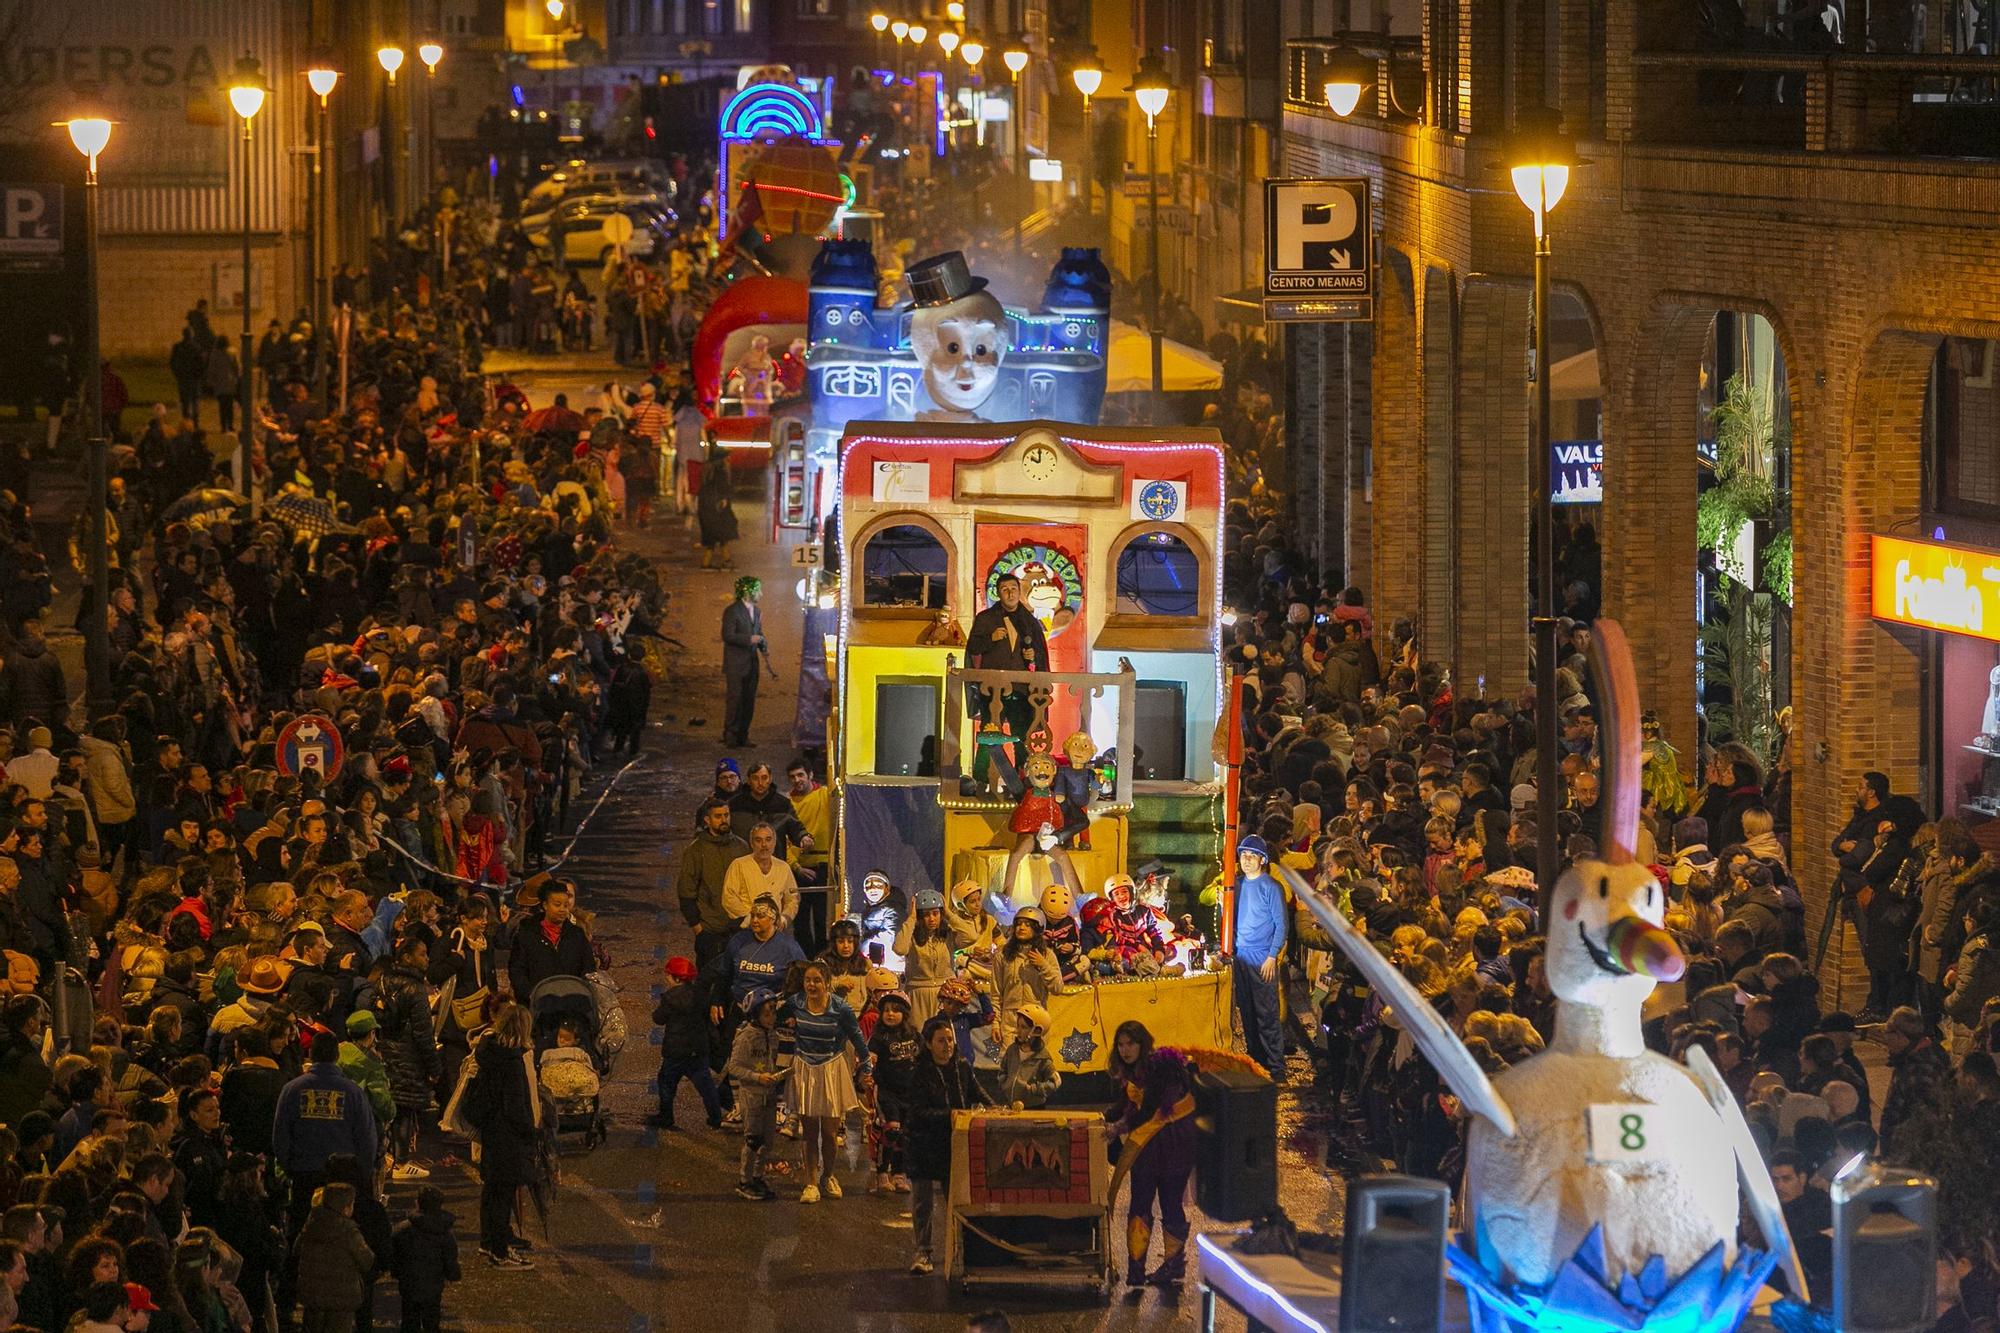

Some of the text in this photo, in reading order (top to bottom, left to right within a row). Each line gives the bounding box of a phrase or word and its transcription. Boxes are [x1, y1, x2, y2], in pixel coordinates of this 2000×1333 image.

[6, 189, 45, 237] P
[1277, 186, 1357, 269] P
[1271, 277, 1364, 288] CENTRO MEANAS
[797, 547, 819, 564] 15
[1045, 548, 1082, 606] PEDAL
[739, 958, 776, 973] Pasek
[1620, 1113, 1646, 1151] 8
